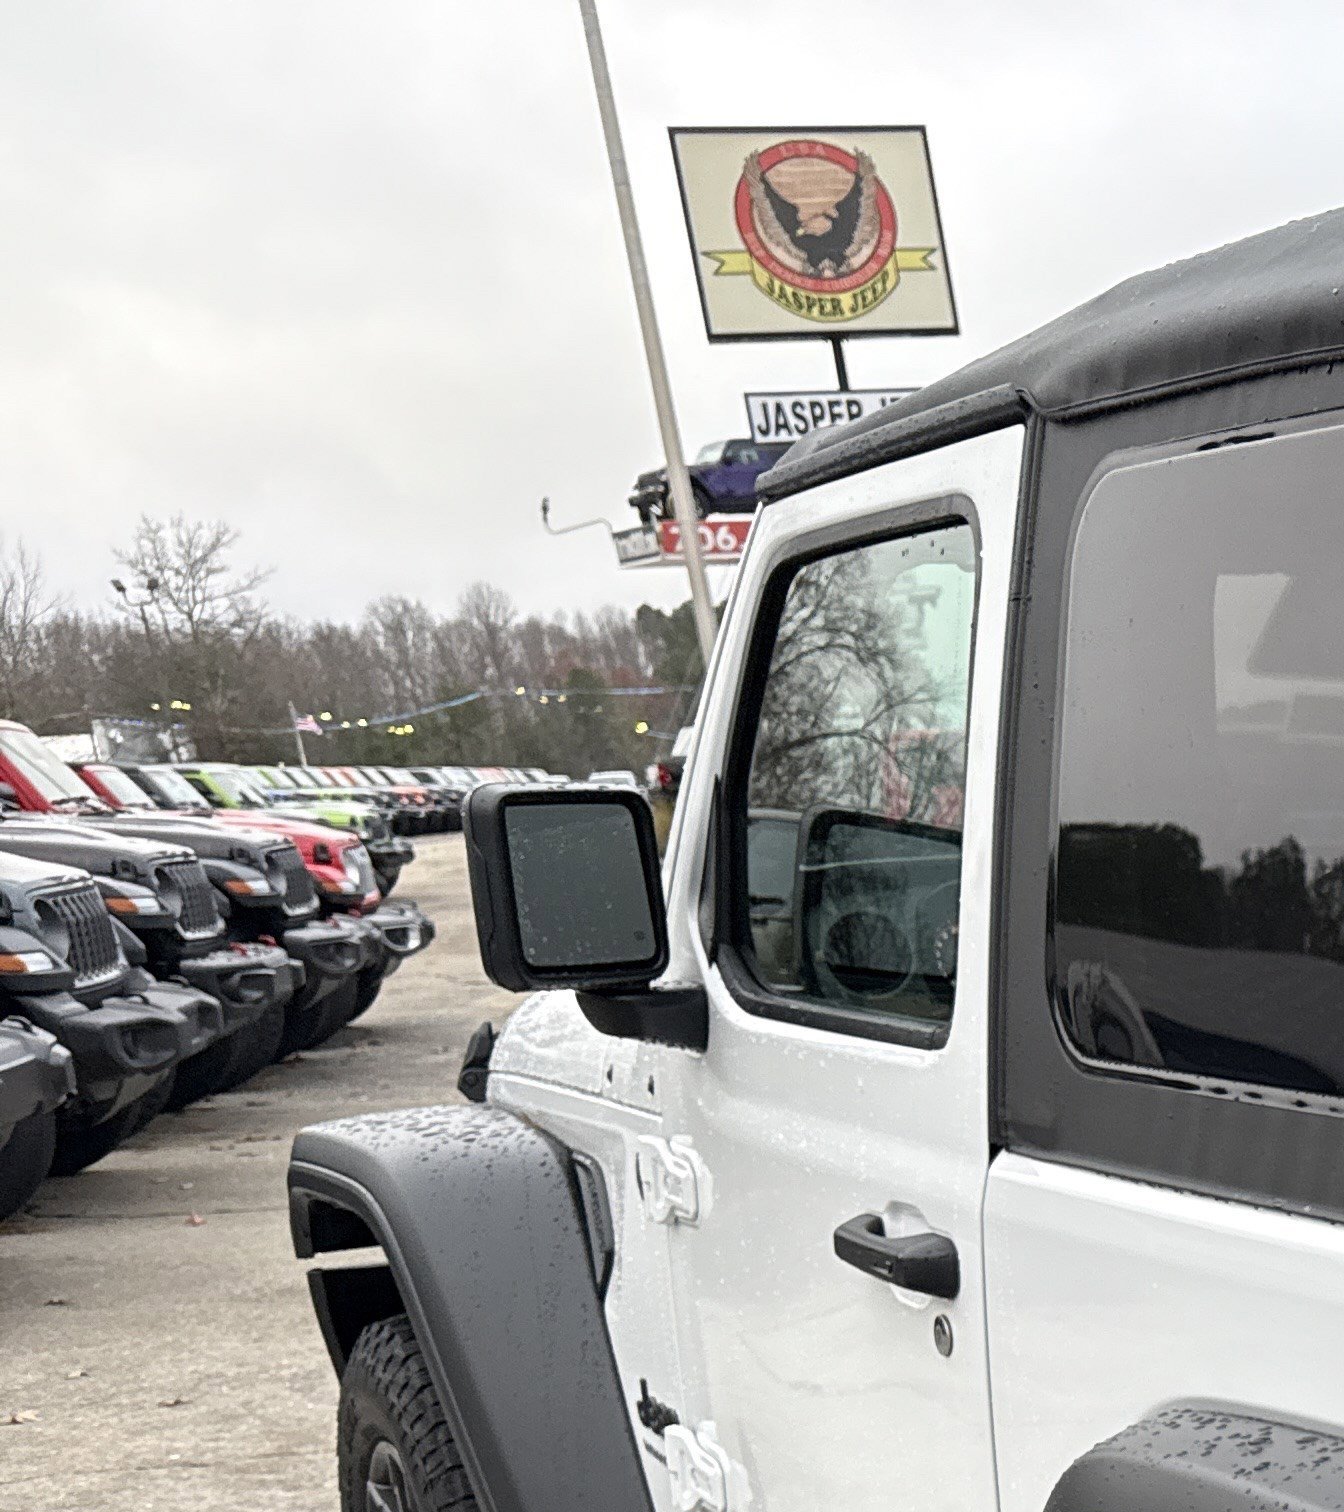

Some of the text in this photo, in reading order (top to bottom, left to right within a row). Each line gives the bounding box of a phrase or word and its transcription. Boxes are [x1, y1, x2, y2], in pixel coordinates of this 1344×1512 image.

[766, 270, 890, 316] JASPER JEEP
[757, 399, 864, 437] JASPER
